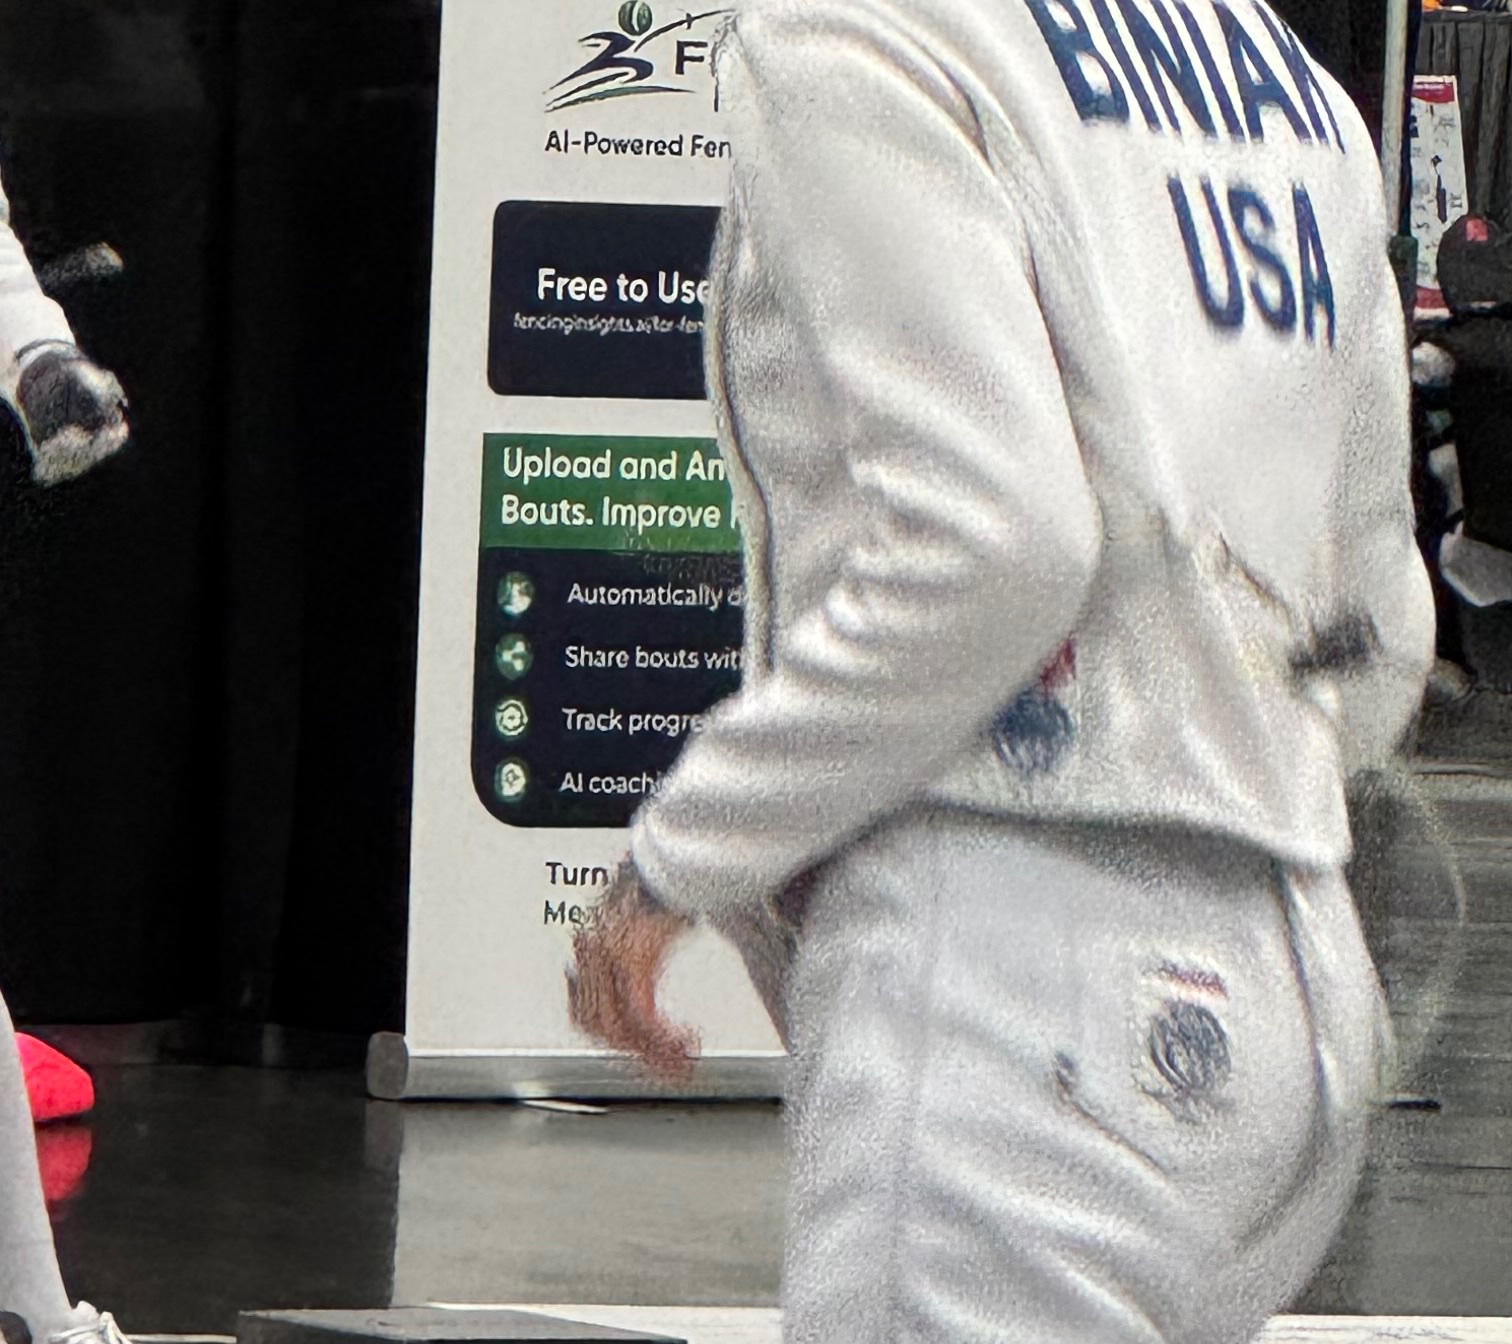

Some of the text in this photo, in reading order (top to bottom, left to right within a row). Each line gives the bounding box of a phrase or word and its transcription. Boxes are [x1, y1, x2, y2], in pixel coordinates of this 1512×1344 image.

[544, 129, 683, 157] AI-Powered
[1166, 172, 1336, 351] USA
[537, 267, 608, 302] Free
[617, 273, 649, 303] to
[503, 447, 725, 485] Upload and An
[501, 494, 594, 526] Bouts.
[602, 496, 721, 535] Improve
[567, 582, 723, 612] Automatically
[564, 646, 741, 670] Share bouts wit
[561, 708, 622, 732] Track
[560, 772, 583, 792] AI
[545, 861, 609, 886] Turn
